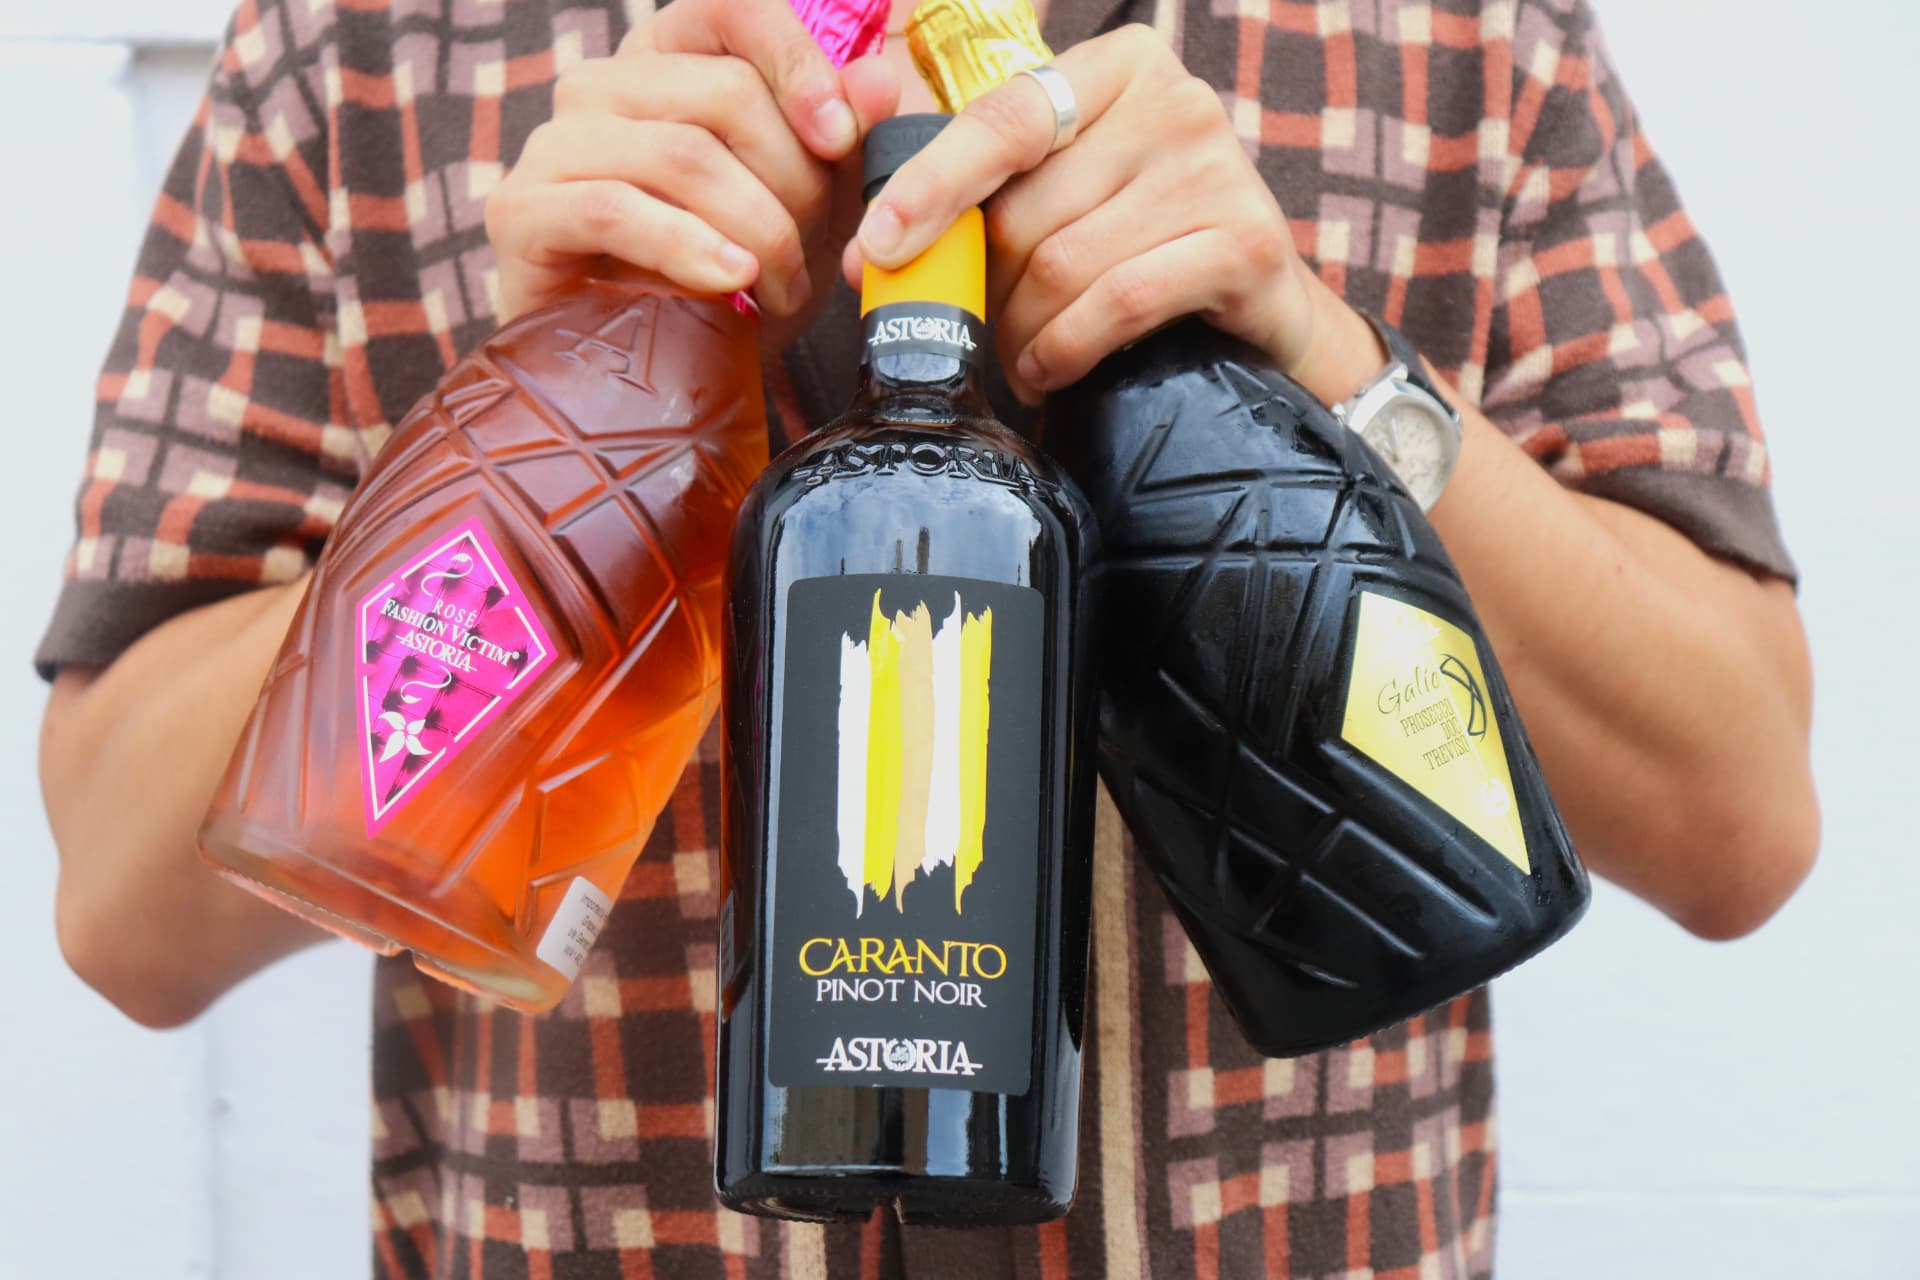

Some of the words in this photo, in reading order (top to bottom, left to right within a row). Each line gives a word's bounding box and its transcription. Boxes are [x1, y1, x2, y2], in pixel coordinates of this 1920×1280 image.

[868, 316, 977, 350] ASTORIA
[381, 598, 448, 637] FASHION
[431, 599, 477, 629] ROSÉ
[395, 630, 478, 673] ASTORIA
[1400, 697, 1455, 738] PROSECCO
[1440, 716, 1462, 741] DOC
[1423, 734, 1470, 771] TREVISO
[799, 938, 1007, 979] CARANTO
[816, 978, 904, 1002] PINOT
[914, 979, 987, 1008] NOIR
[816, 1037, 983, 1076] ASTORIA
